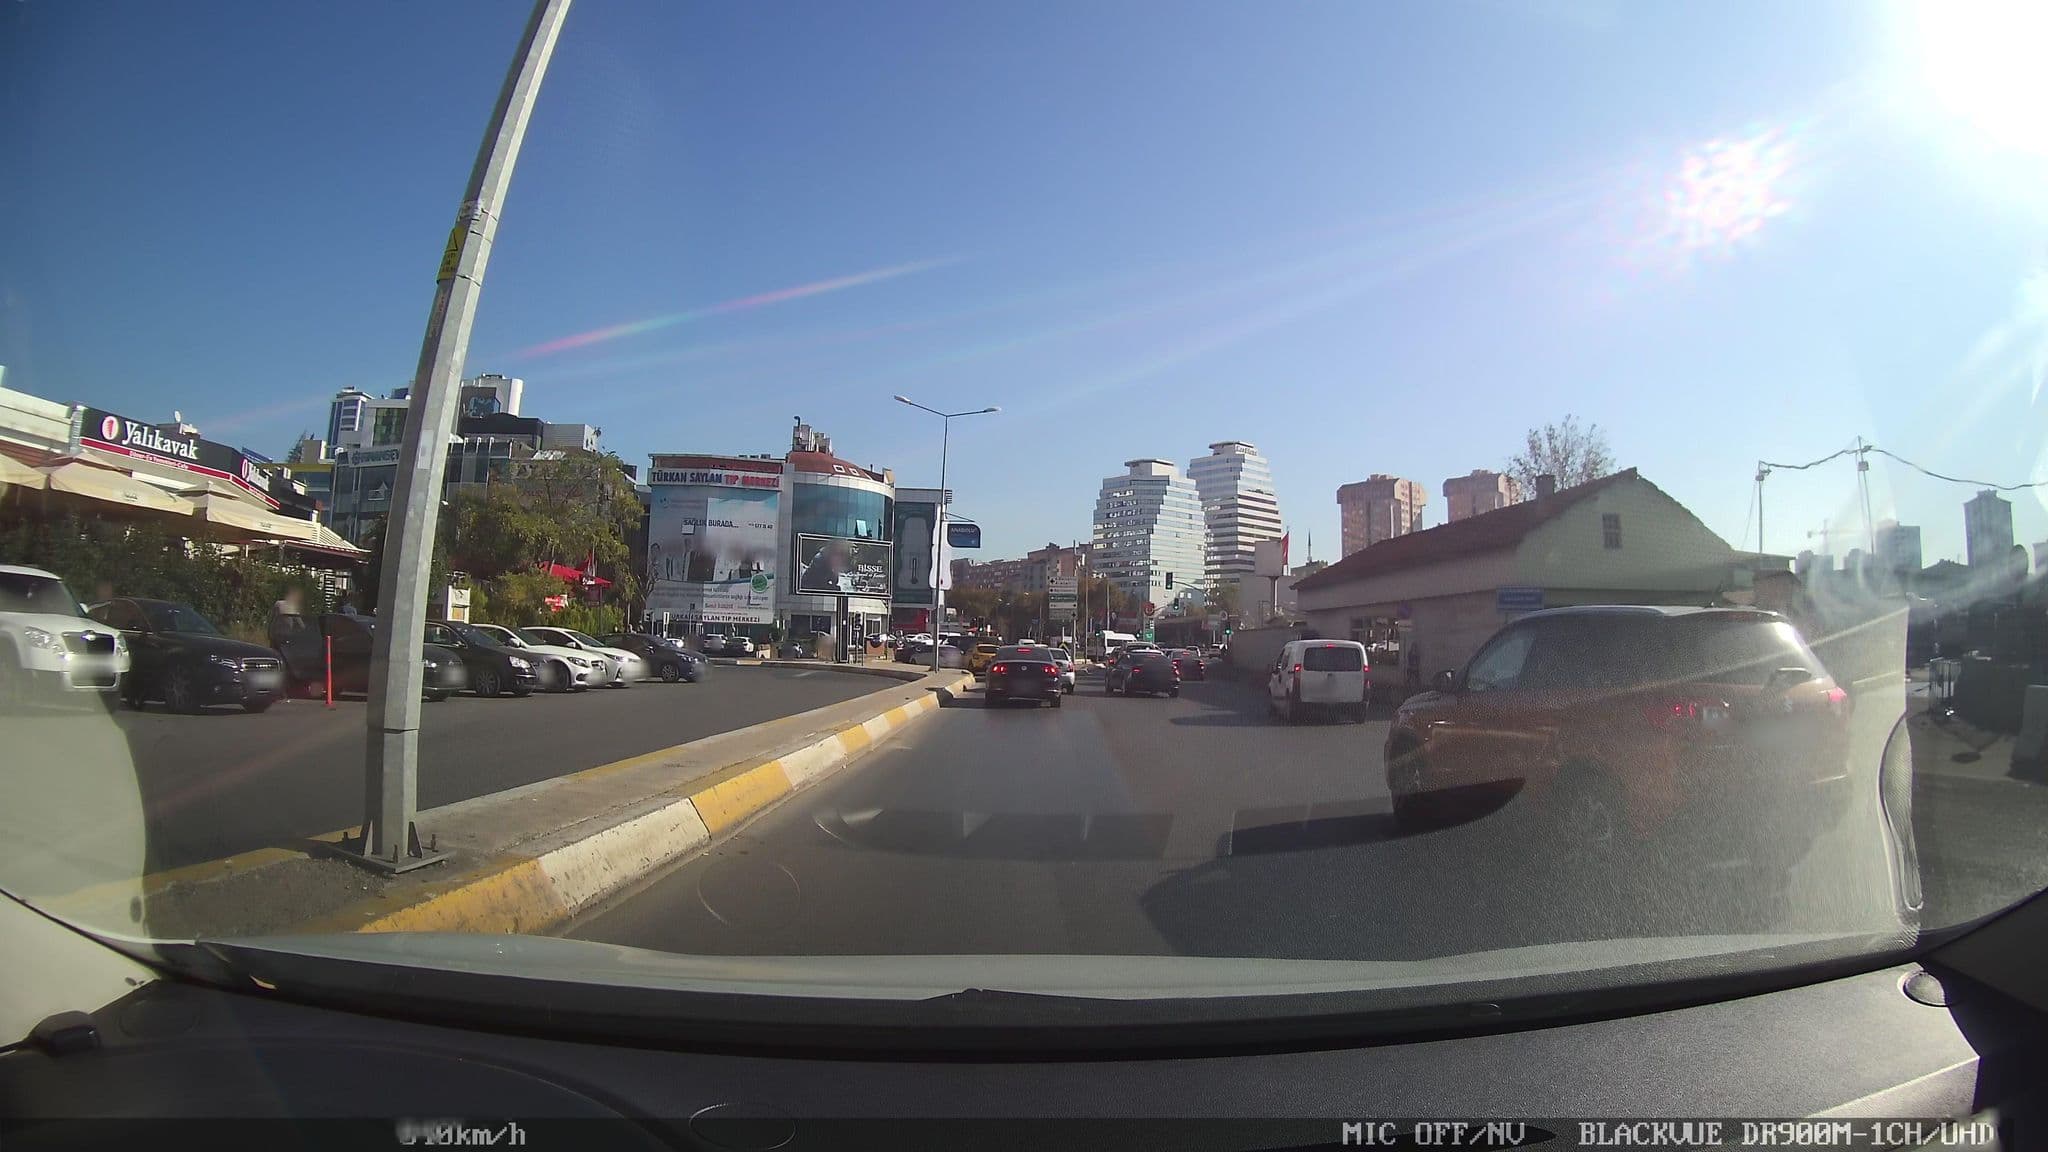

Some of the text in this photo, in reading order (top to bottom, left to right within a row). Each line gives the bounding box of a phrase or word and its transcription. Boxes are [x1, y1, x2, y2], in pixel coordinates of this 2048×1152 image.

[122, 420, 199, 460] Yalıkavak
[652, 469, 687, 483] TÜRKAN
[689, 472, 722, 484] SAYLAN
